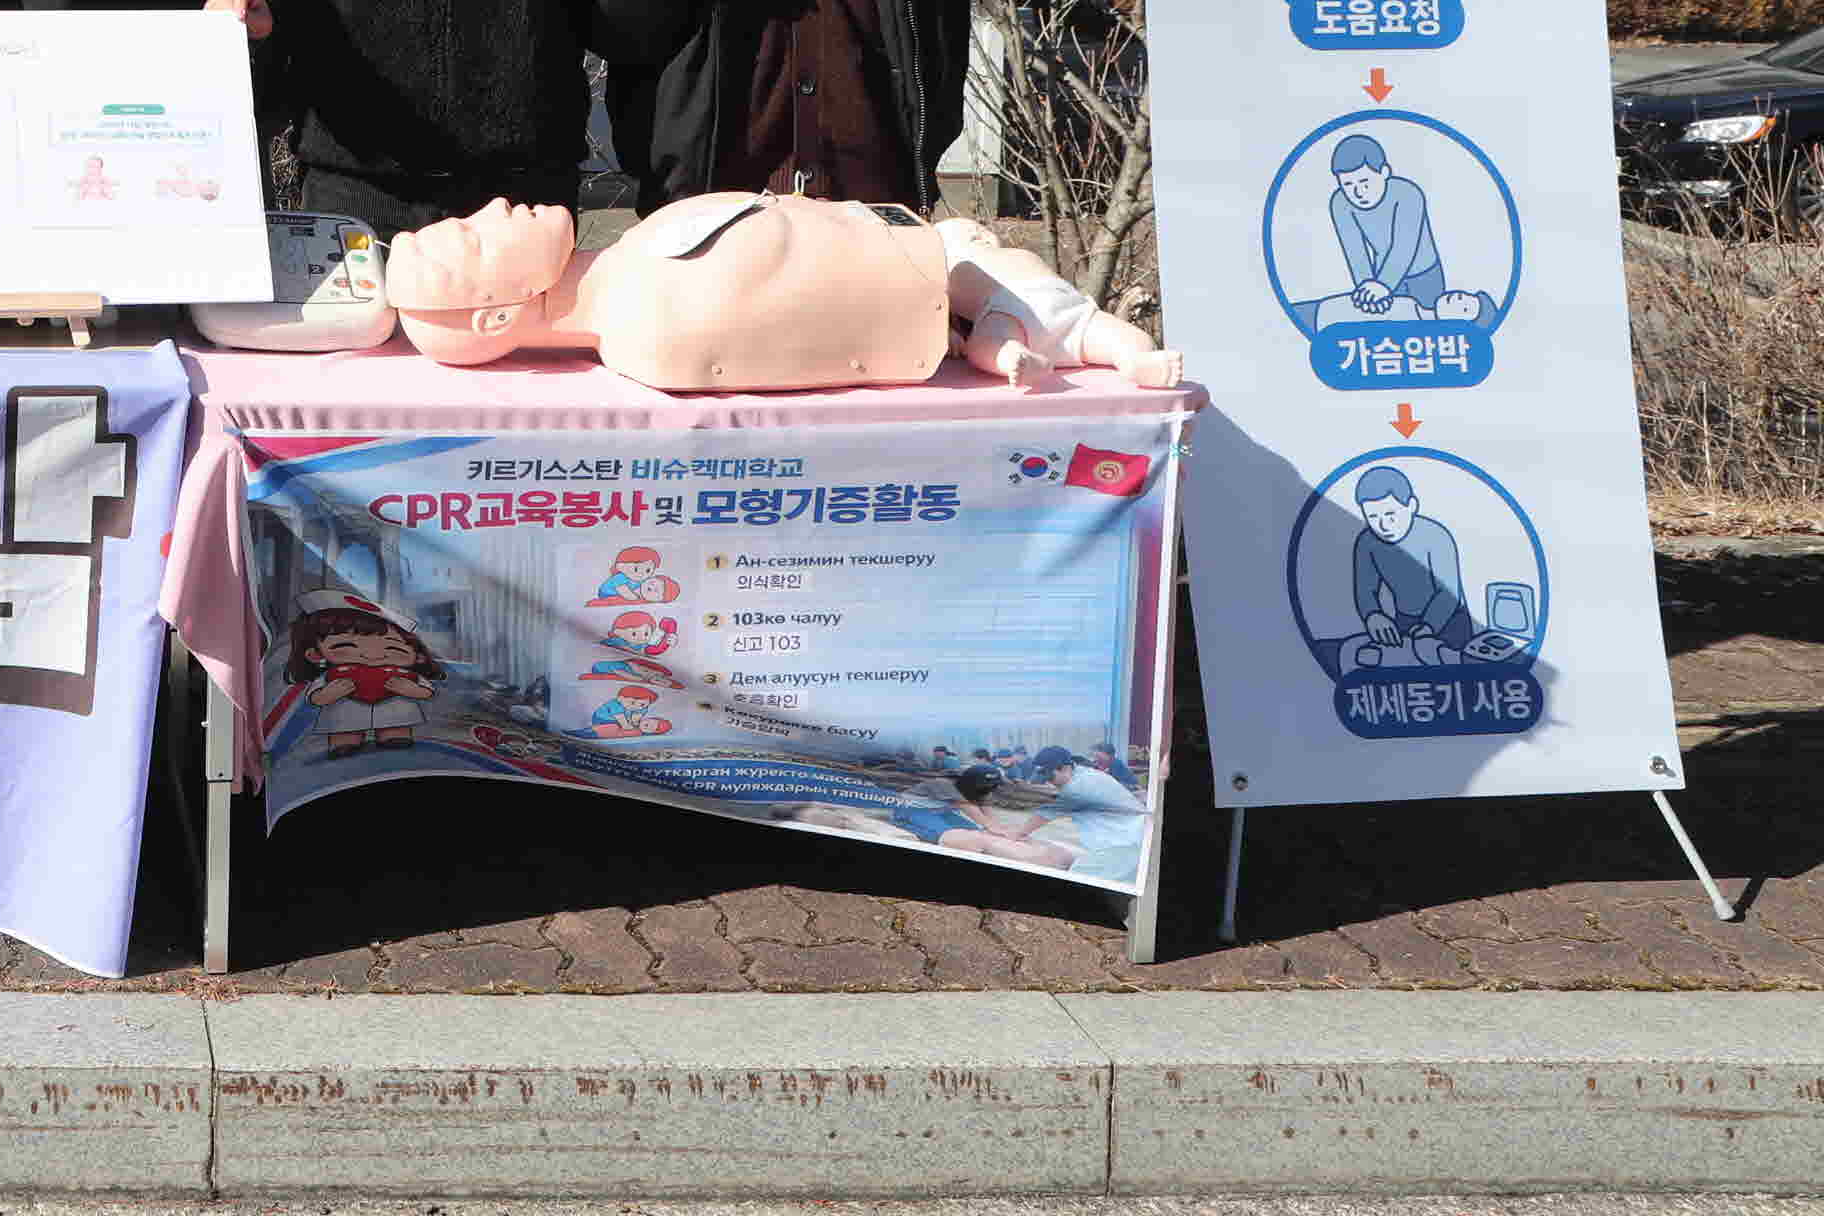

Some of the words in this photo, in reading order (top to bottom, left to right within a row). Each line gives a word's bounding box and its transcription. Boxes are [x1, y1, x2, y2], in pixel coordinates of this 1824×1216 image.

[1338, 335, 1471, 376] 가슴압박
[466, 459, 623, 481] 키르기스스탄
[368, 490, 649, 530] CPR교육봉사
[654, 495, 683, 526] 및
[692, 483, 962, 526] 모형기증활동
[736, 554, 845, 569] Ан-сезимин
[737, 573, 802, 590] 의식확인
[733, 636, 763, 652] 신고
[769, 635, 802, 651] 103
[728, 672, 768, 686] Дем
[1345, 681, 1465, 723] 제세동기
[1472, 679, 1532, 720] 사용
